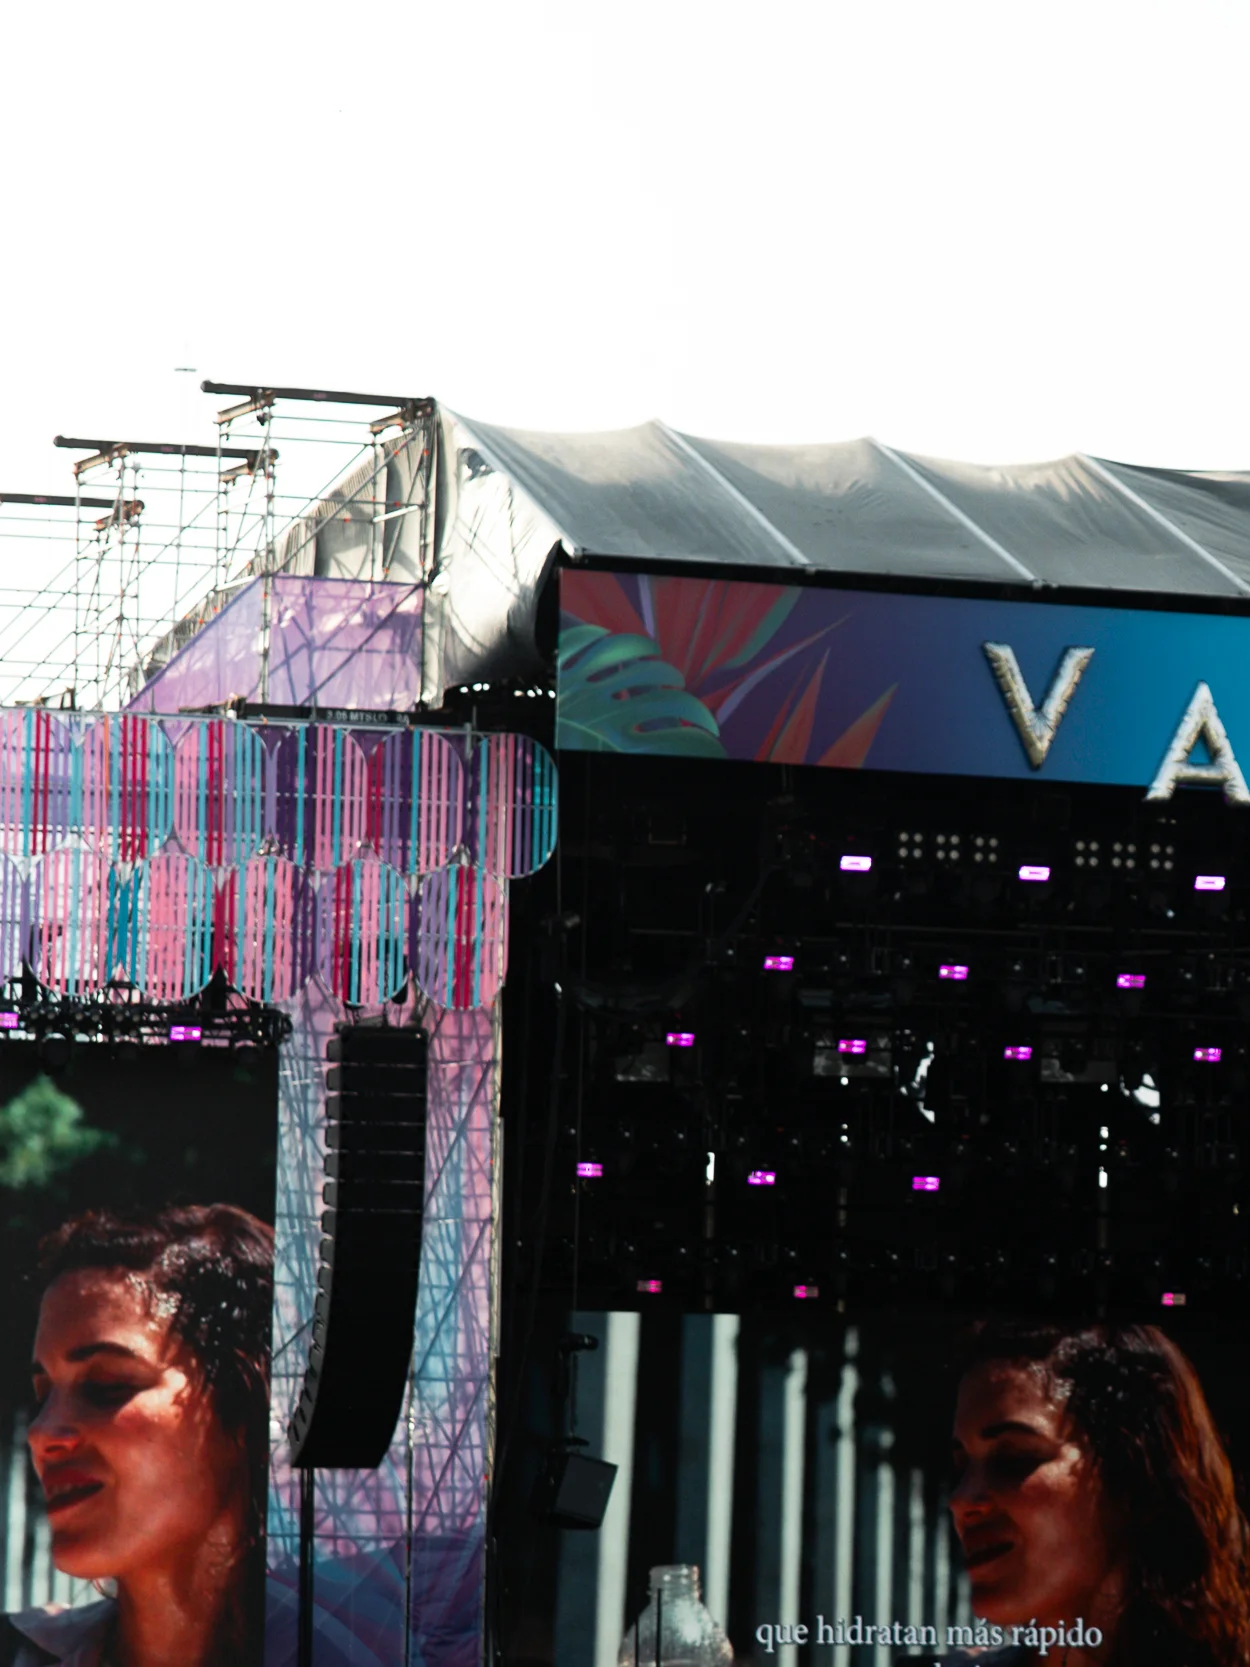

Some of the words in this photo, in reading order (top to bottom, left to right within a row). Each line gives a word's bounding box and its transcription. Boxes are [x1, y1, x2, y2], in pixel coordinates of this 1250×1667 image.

[755, 1621, 809, 1653] que
[816, 1615, 938, 1646] hidratan
[946, 1617, 1003, 1647] más
[1011, 1617, 1103, 1656] rápido
